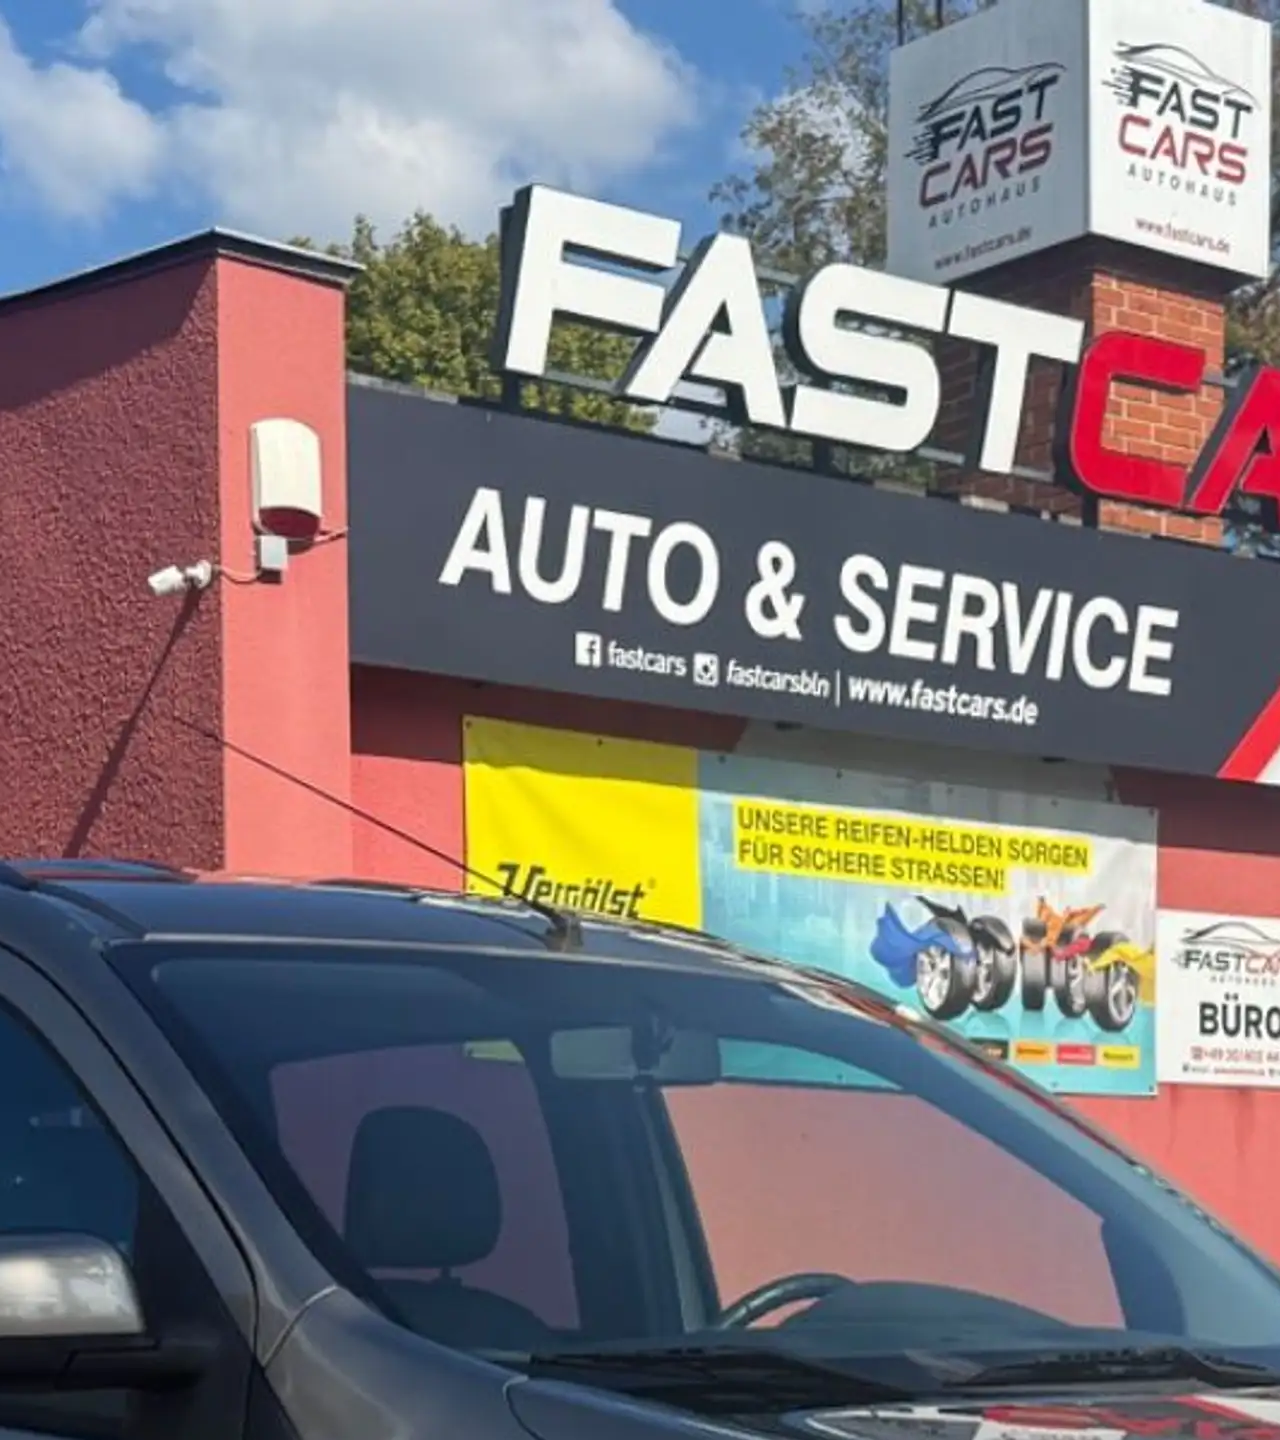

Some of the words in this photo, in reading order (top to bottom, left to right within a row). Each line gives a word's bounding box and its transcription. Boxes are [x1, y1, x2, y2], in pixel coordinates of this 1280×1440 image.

[920, 74, 1059, 160] FAST
[1124, 64, 1254, 139] FAST
[920, 122, 1054, 209] CARS
[1117, 113, 1248, 185] CARS
[1127, 162, 1237, 206] AUTOHAUS
[928, 175, 1041, 228] AUTOHAUS
[438, 486, 720, 625] AUTO
[744, 540, 805, 641] &
[833, 553, 1180, 696] SERVICE
[607, 641, 688, 678] fastcars
[847, 674, 1040, 726] www.fastcars.de
[737, 806, 829, 839] UNSERE
[835, 816, 1004, 859] REIFEN-HELDEN
[1007, 839, 1089, 869] SORGEN
[738, 836, 785, 866] FÜR
[789, 845, 886, 878] SICHERE
[890, 857, 1006, 890] STRASSEN!
